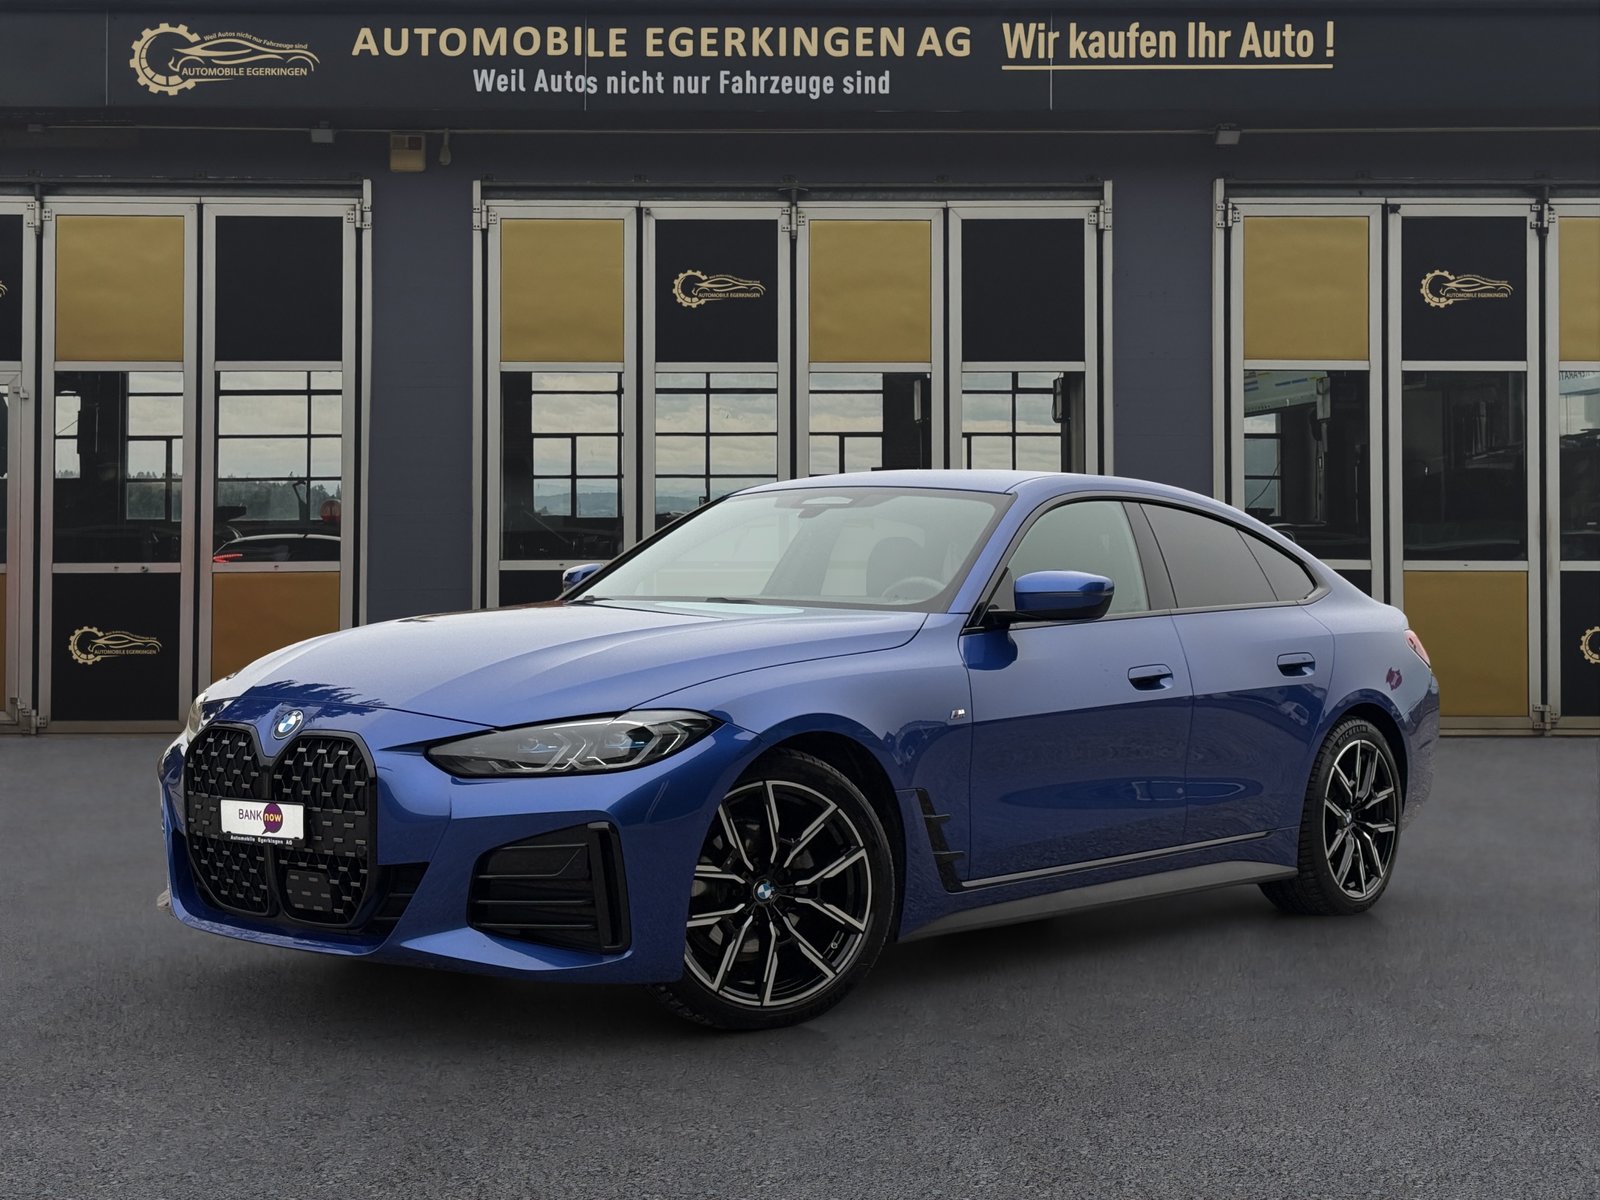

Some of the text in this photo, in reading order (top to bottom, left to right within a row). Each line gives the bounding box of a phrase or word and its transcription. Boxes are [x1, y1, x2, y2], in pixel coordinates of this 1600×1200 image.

[203, 33, 217, 41] Weil
[236, 31, 252, 40] nicht
[252, 36, 263, 44] nur
[262, 38, 293, 50] Fahrzeuge
[351, 26, 971, 58] AUTOMOBILE EGERKINGEN AG
[1002, 22, 1060, 59] Wir
[1069, 22, 1177, 59] kaufen
[1187, 21, 1232, 58] Ihr
[1239, 21, 1314, 58] Auto
[181, 67, 308, 77] AUTOMOBILE EGERKINGEN
[473, 68, 890, 100] Weil Autos nicht nur Fahrzeuge sind
[238, 808, 282, 823] BANK now
[230, 834, 256, 842] Automobile
[257, 837, 284, 846] Egerkingen
